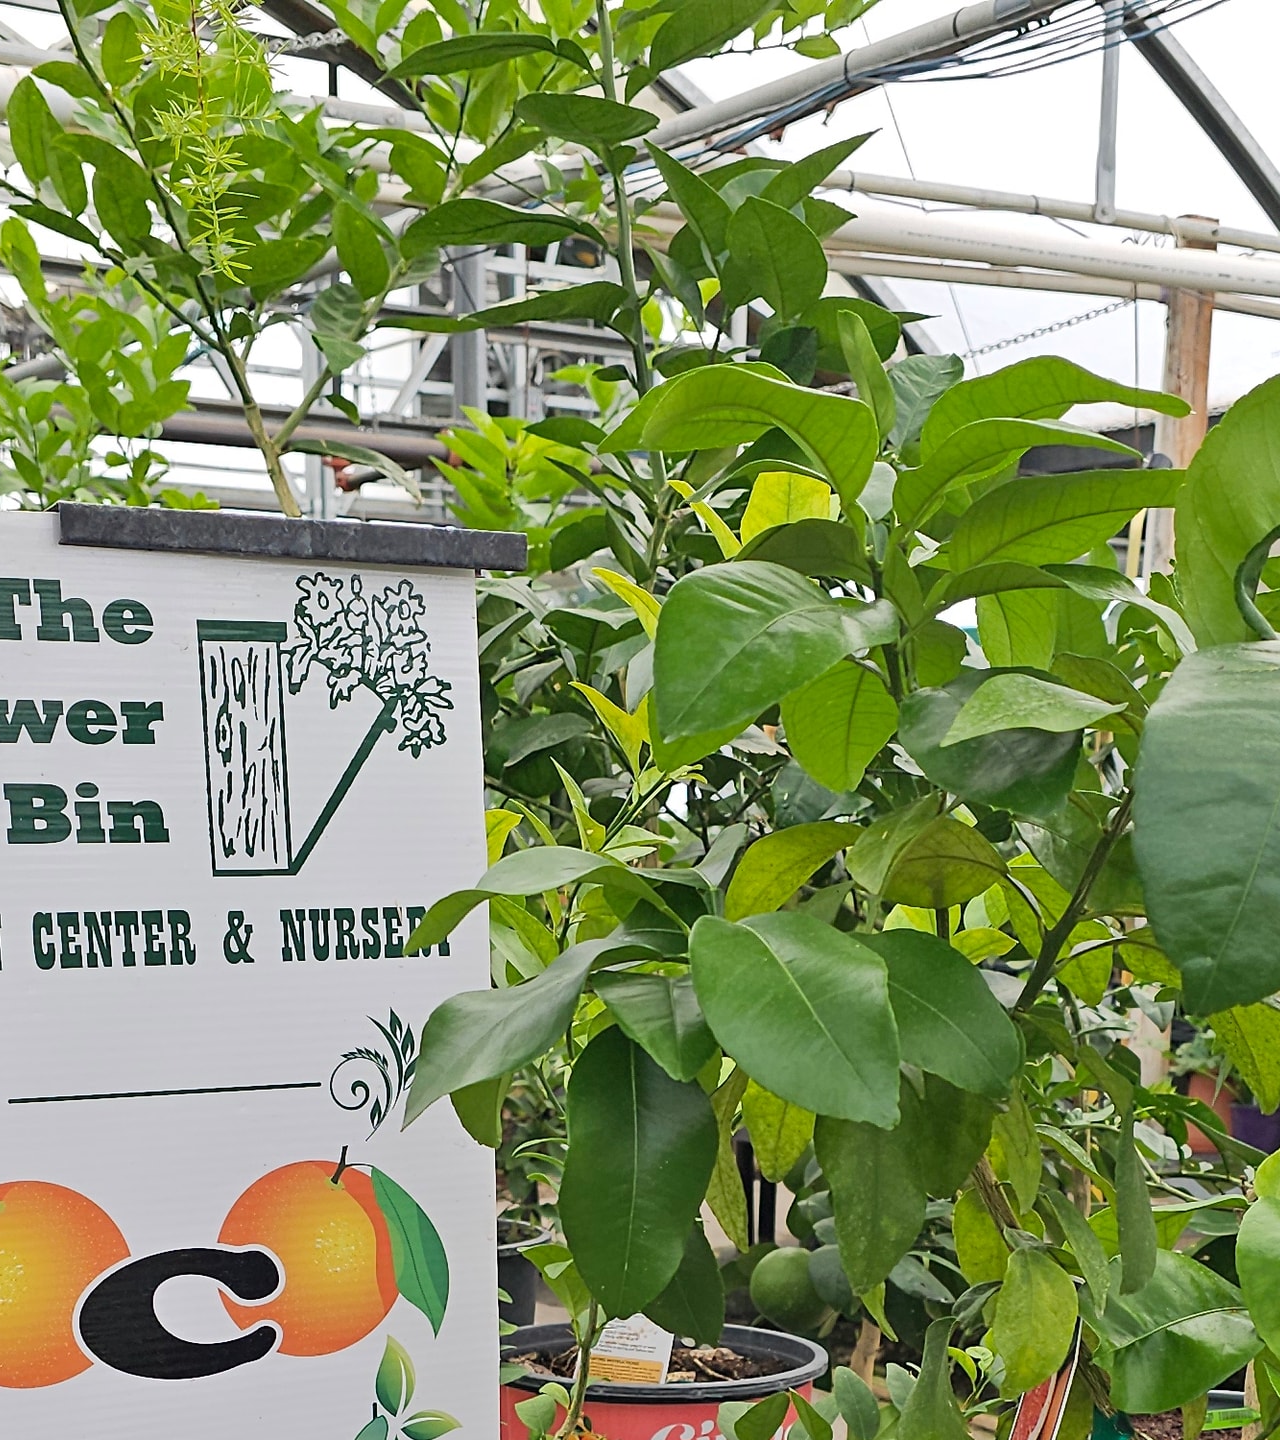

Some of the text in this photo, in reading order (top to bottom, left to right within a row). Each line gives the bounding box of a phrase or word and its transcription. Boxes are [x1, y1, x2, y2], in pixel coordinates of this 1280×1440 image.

[3, 781, 170, 845] Bin
[32, 909, 197, 972] CENTER
[222, 910, 255, 964] &
